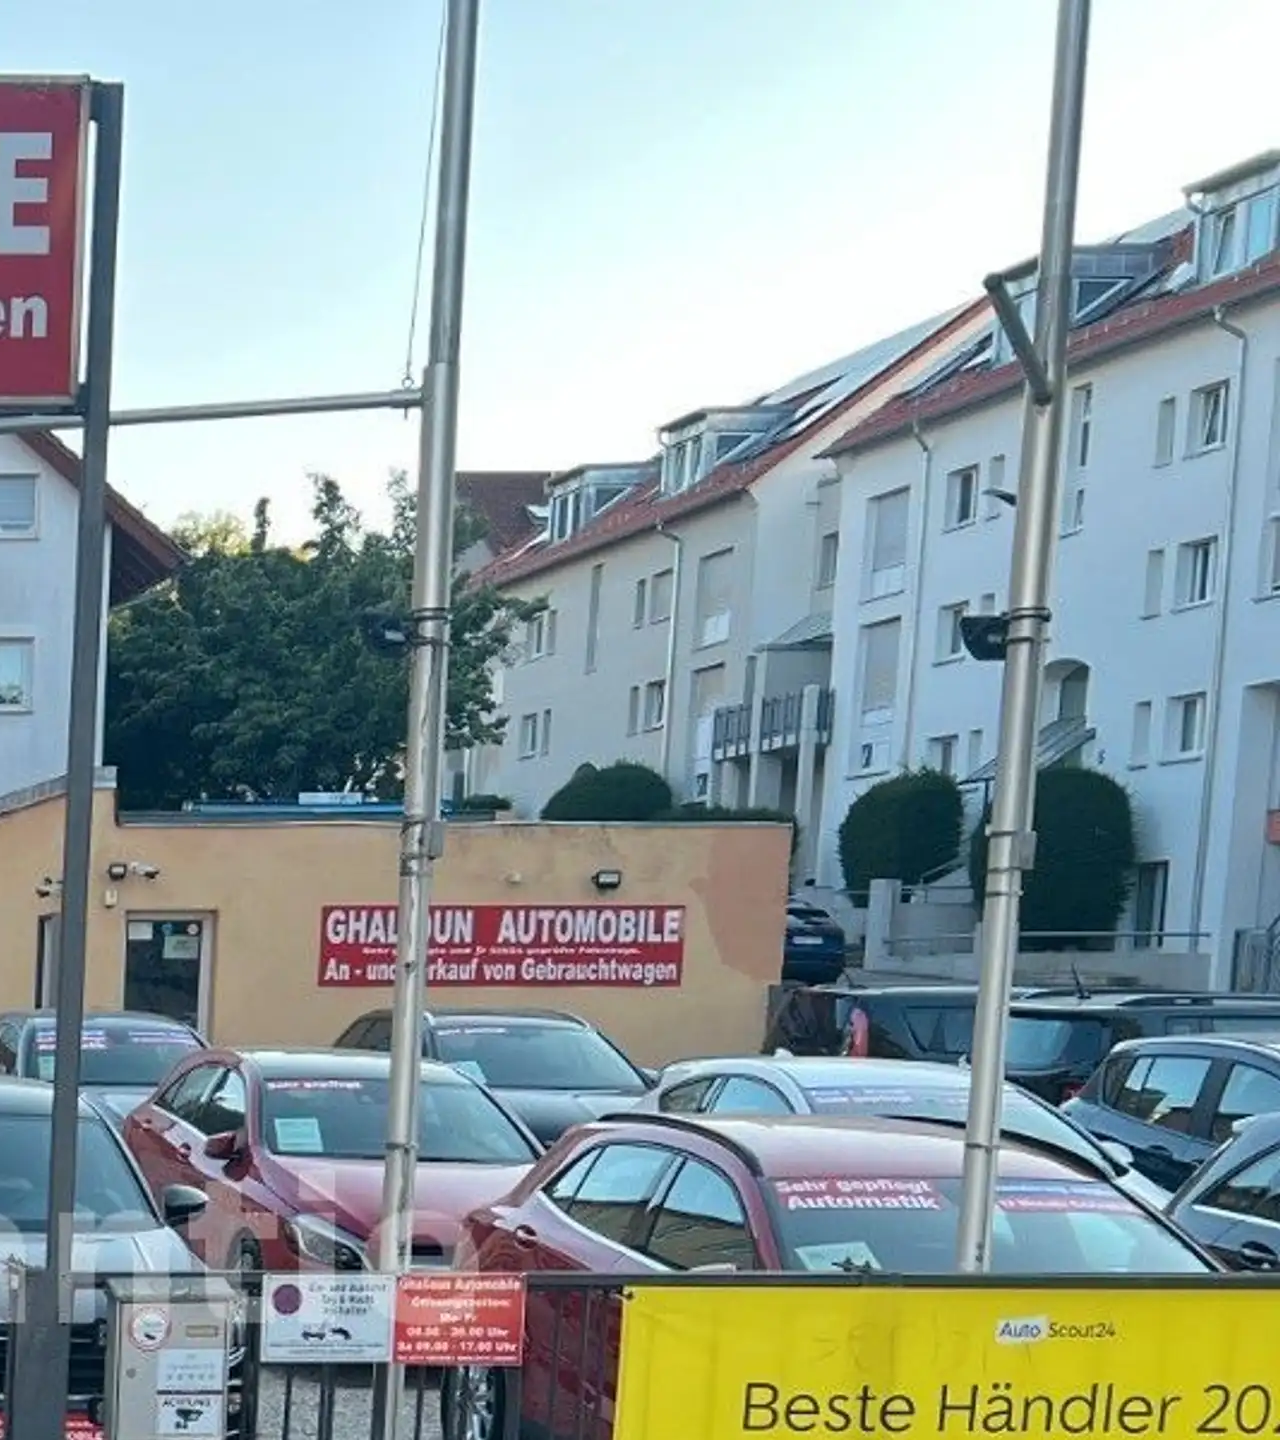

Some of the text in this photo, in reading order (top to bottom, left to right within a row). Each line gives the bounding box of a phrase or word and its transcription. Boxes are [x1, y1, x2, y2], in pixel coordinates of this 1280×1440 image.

[325, 909, 683, 944] GHALUN AUTOMOBILE
[325, 959, 350, 981] An
[427, 958, 478, 982] rkauf
[483, 964, 515, 981] von
[522, 958, 677, 986] Gebrauchtwagen
[776, 1179, 933, 1196] Sehr gepflegt
[787, 1195, 940, 1211] Automatik
[744, 1383, 1280, 1435] Beste Händler 20
